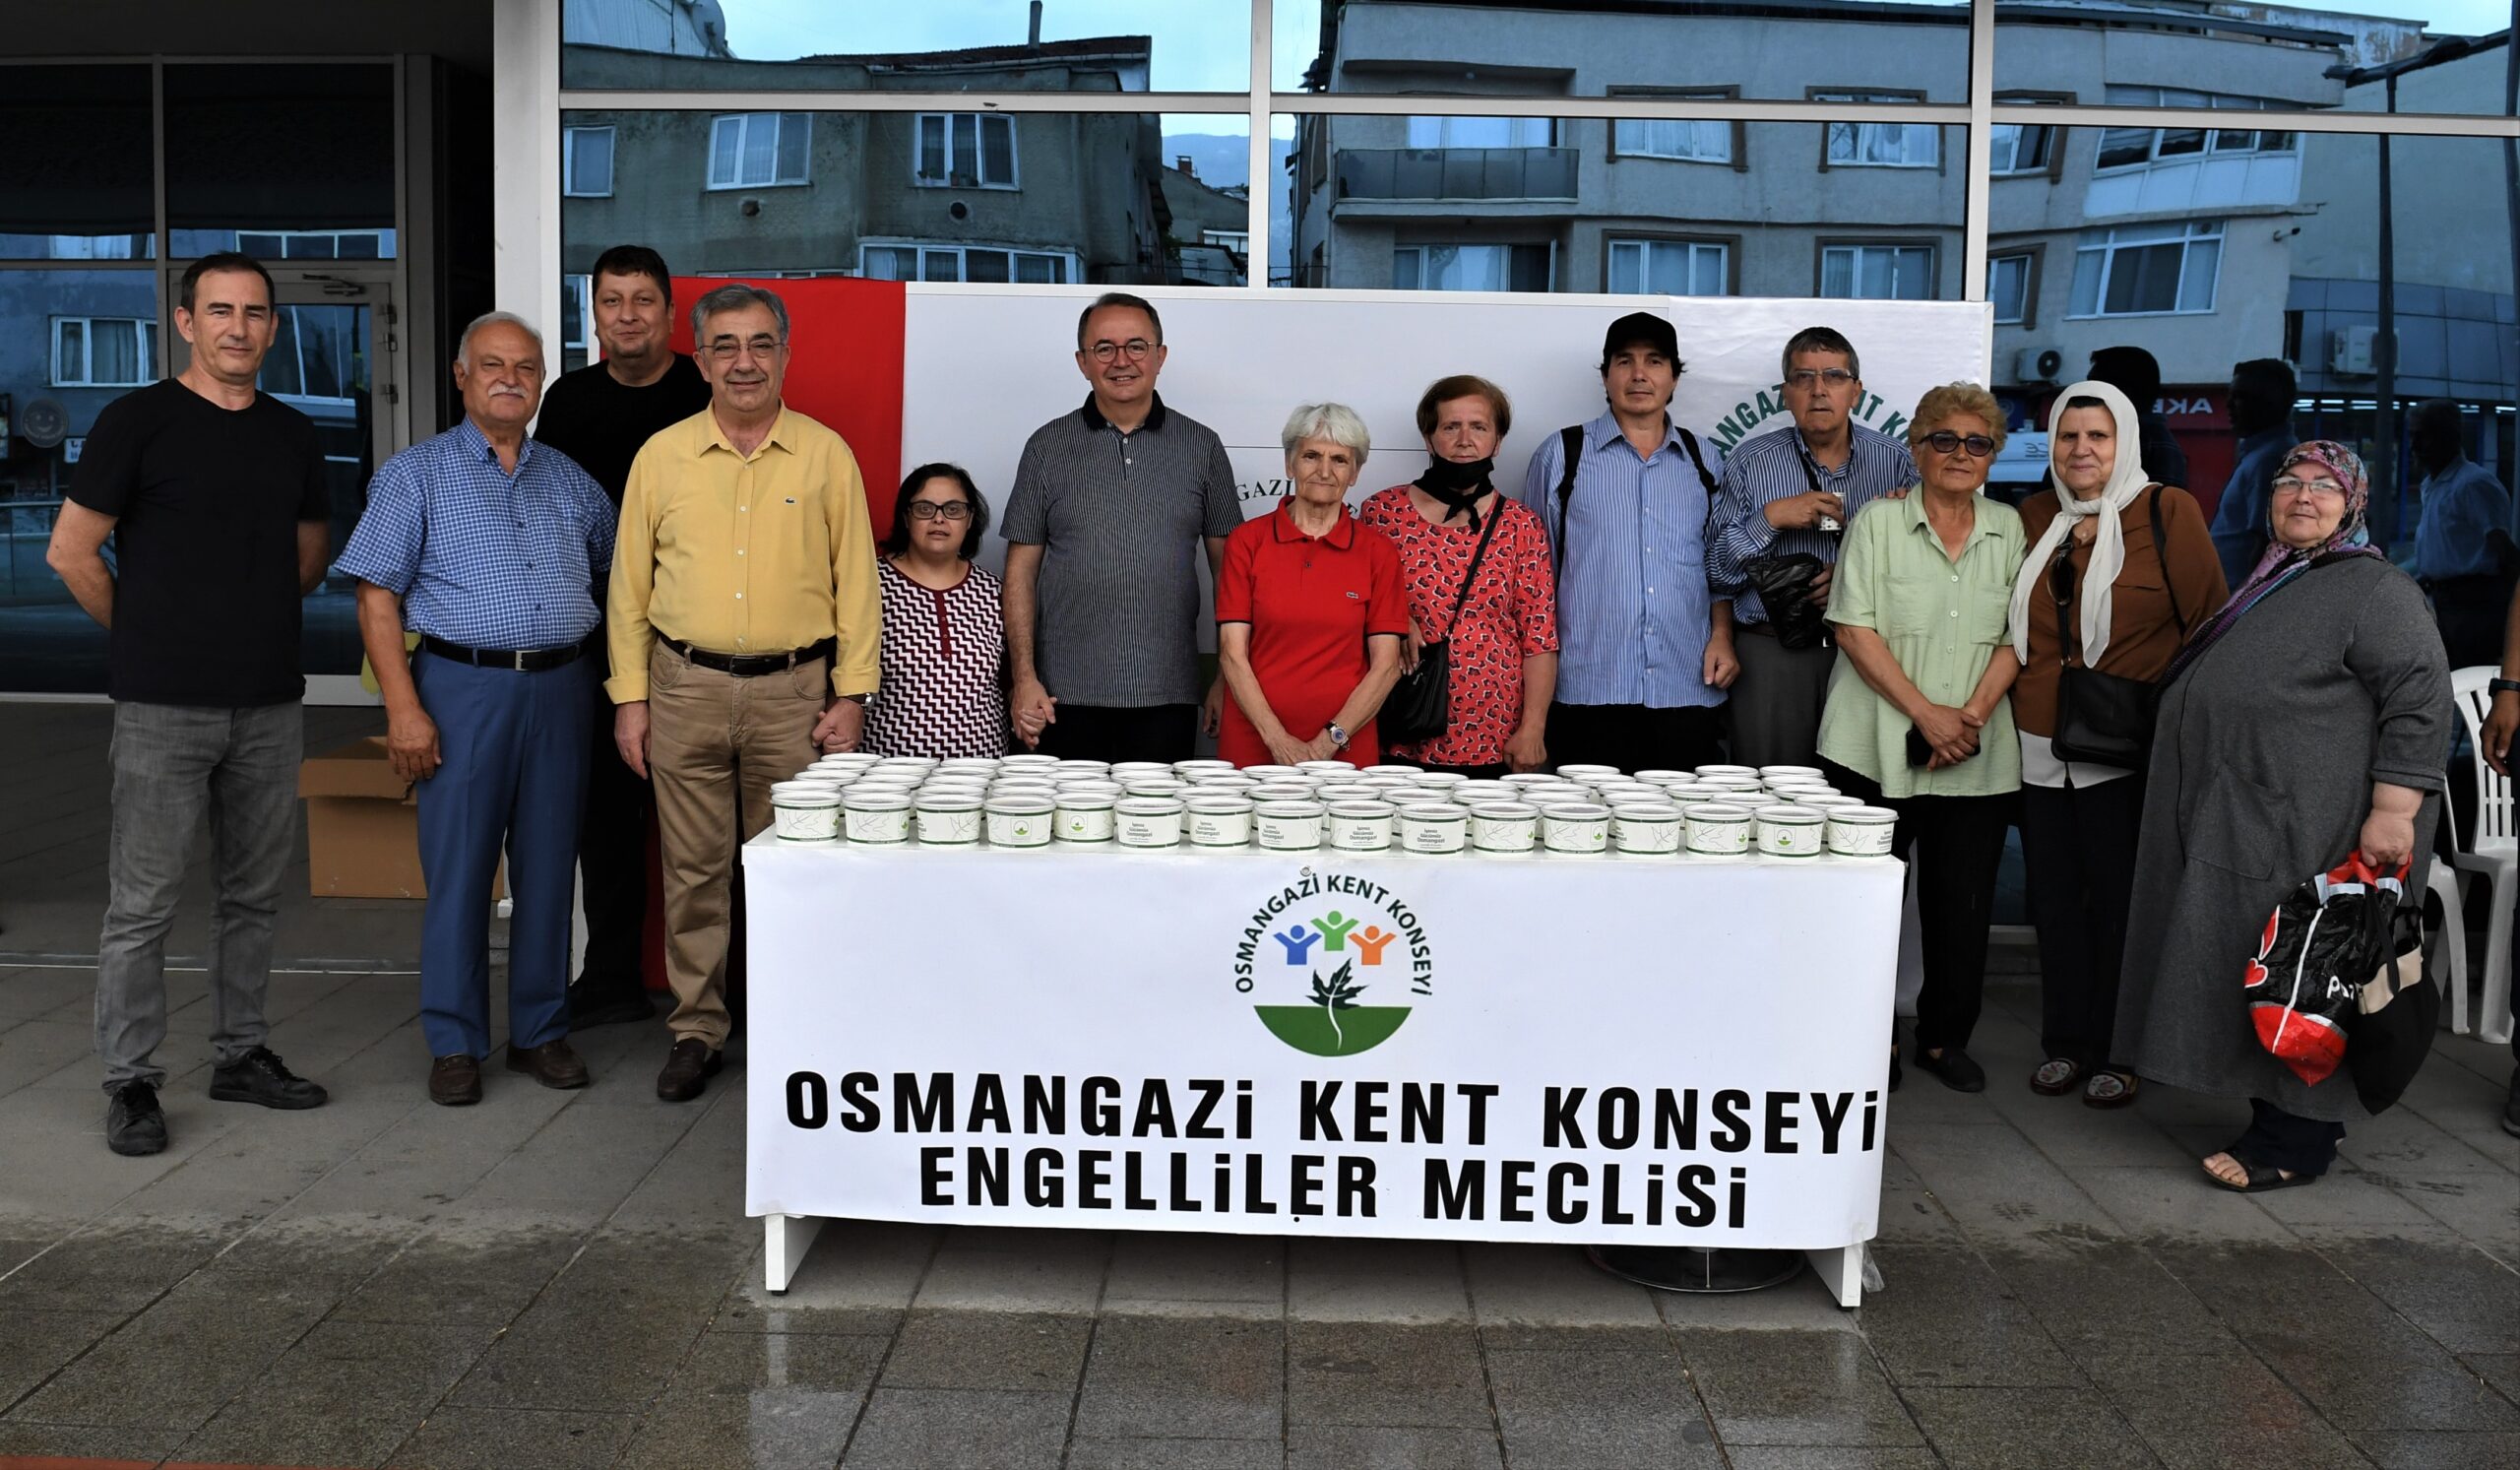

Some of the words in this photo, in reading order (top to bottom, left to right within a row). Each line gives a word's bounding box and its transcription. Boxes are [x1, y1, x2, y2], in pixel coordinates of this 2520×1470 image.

[1707, 383, 1787, 461] ANGAZ
[1327, 874, 1390, 905] KENT
[1299, 1080, 1499, 1146] KENT
